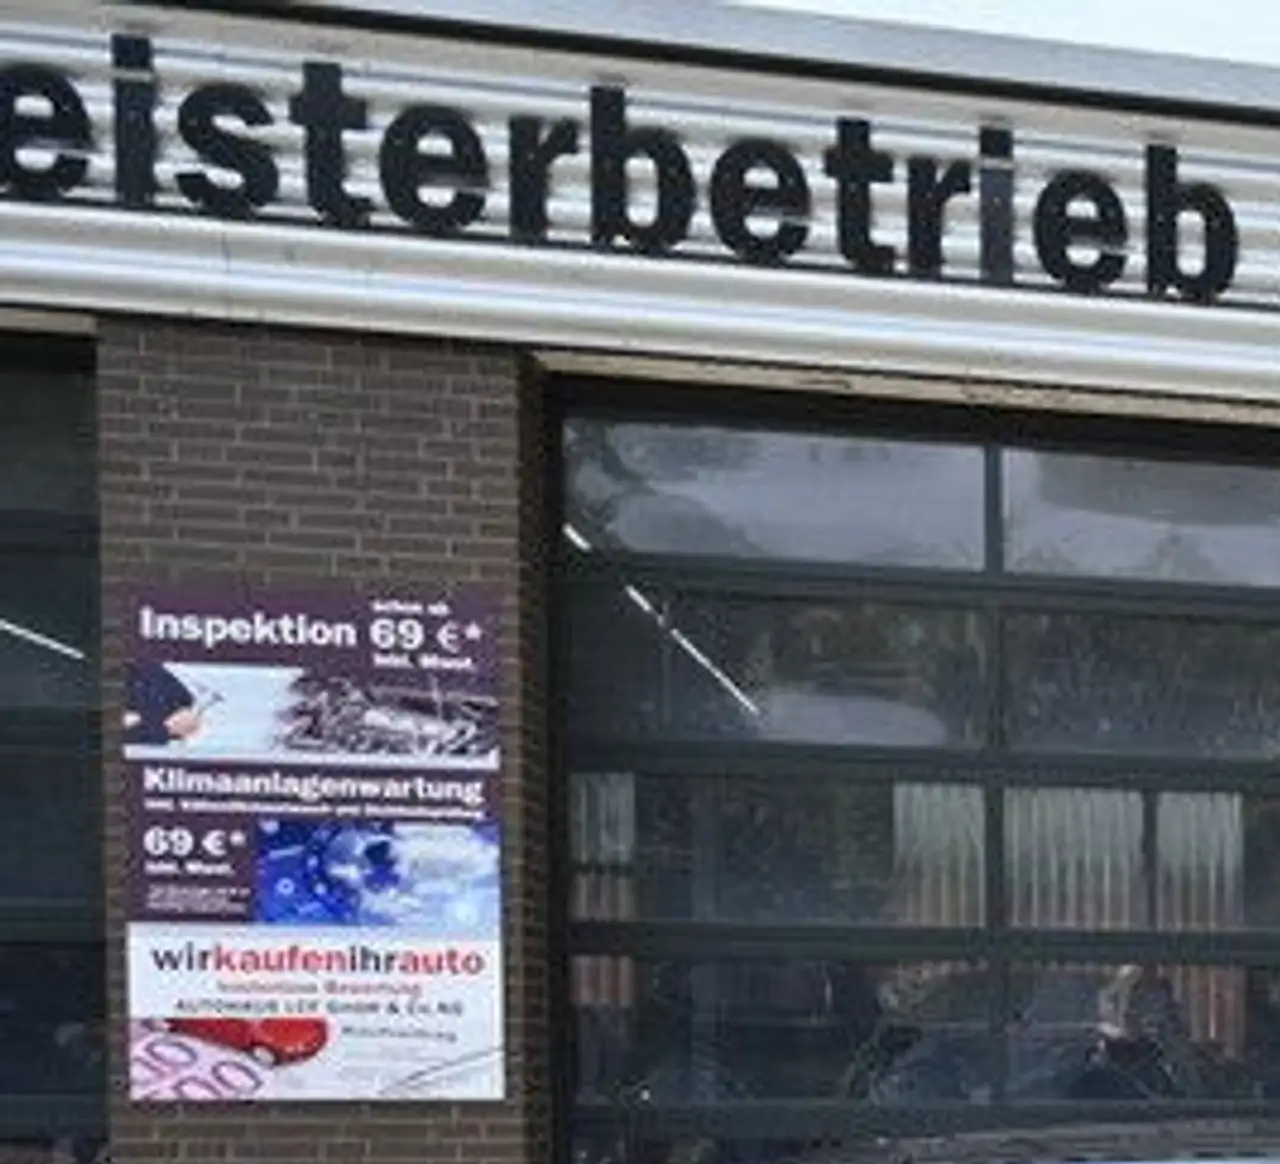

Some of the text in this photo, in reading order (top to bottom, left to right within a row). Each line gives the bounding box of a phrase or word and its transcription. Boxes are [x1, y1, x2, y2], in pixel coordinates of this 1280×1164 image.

[0, 35, 1240, 303] eisterbetrieb
[140, 605, 357, 648] Inspektion
[370, 618, 424, 650] 69
[143, 767, 484, 806] Klimaanlagenwartung
[144, 827, 194, 856] 69
[152, 941, 486, 976] wirkaufenihrauto
